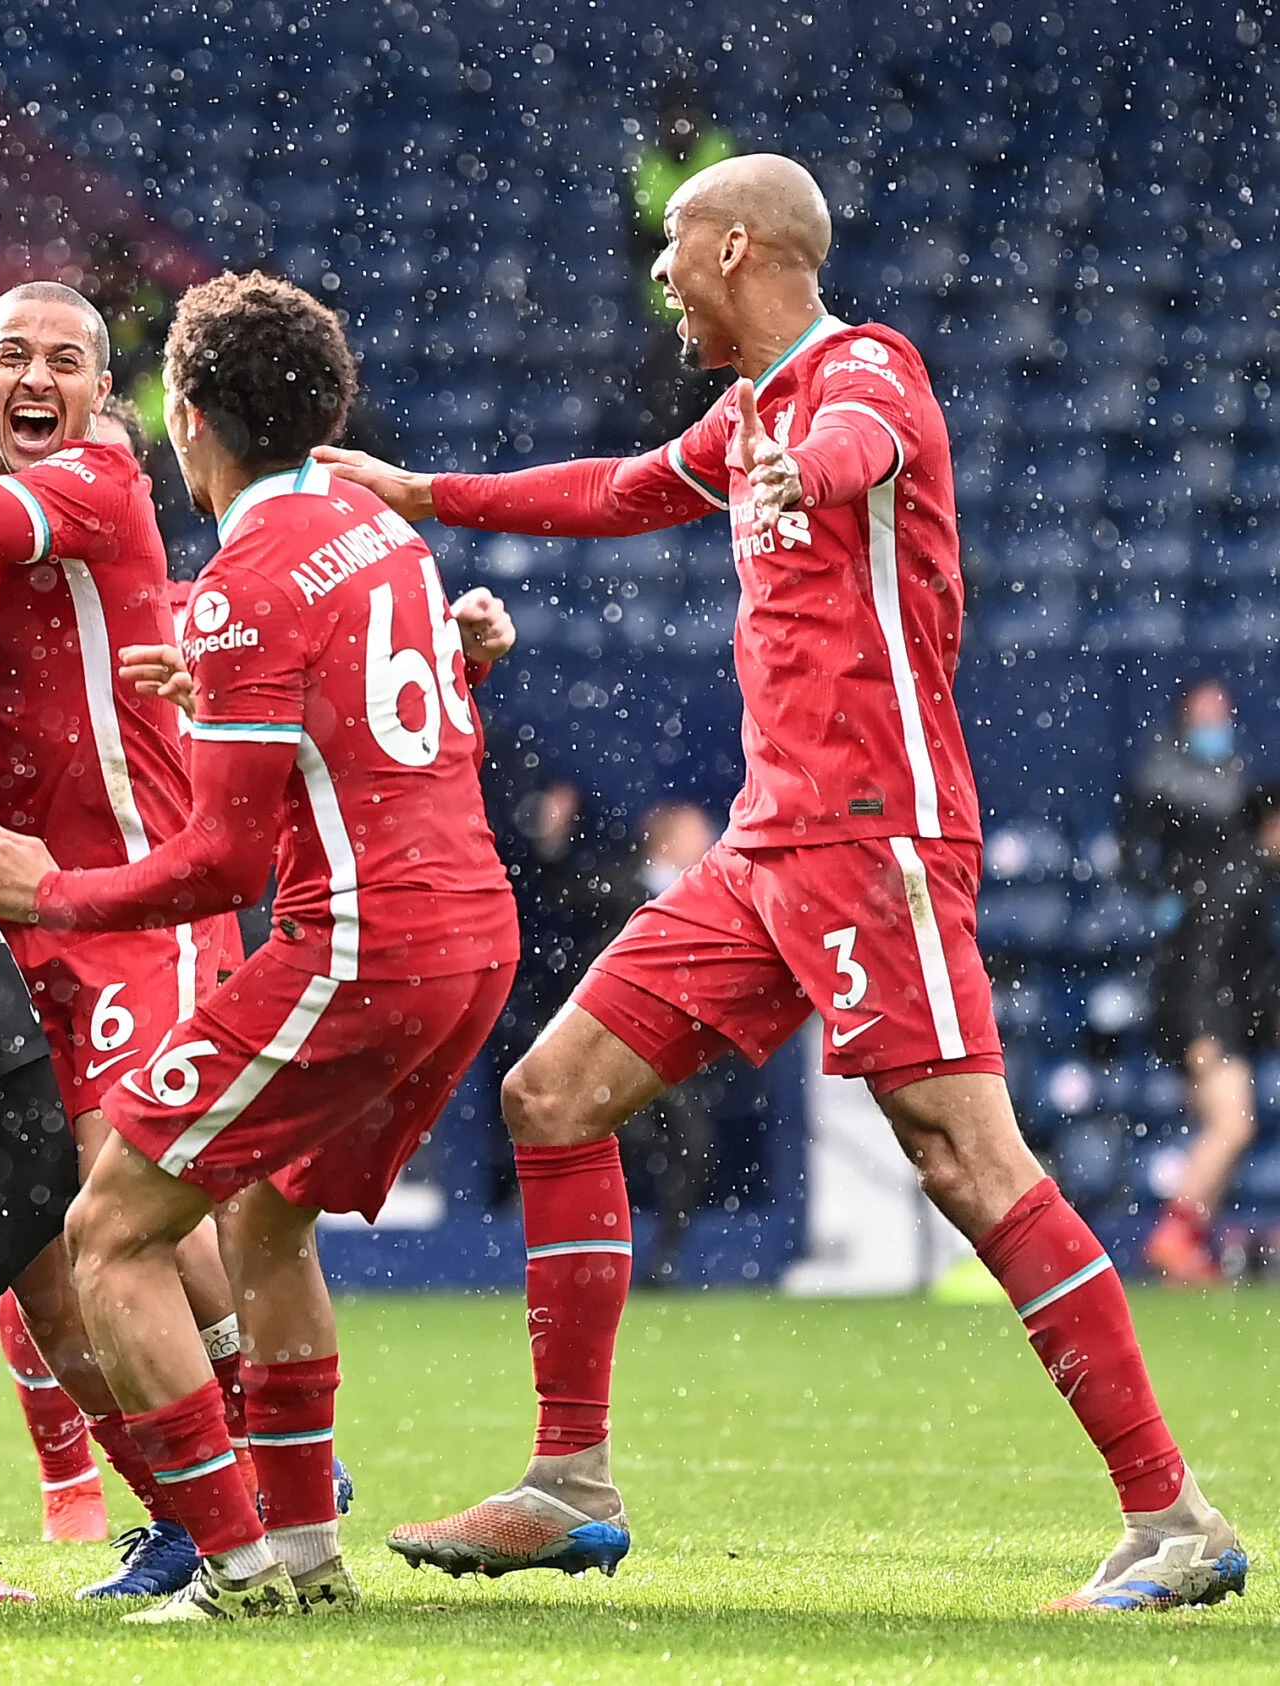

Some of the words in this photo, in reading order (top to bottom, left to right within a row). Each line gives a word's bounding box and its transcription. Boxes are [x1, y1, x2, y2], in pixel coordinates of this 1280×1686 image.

[823, 359, 906, 398] Expedia
[29, 457, 97, 485] pedia
[364, 555, 475, 768] 66
[823, 926, 869, 1010] 3
[90, 982, 135, 1052] 6
